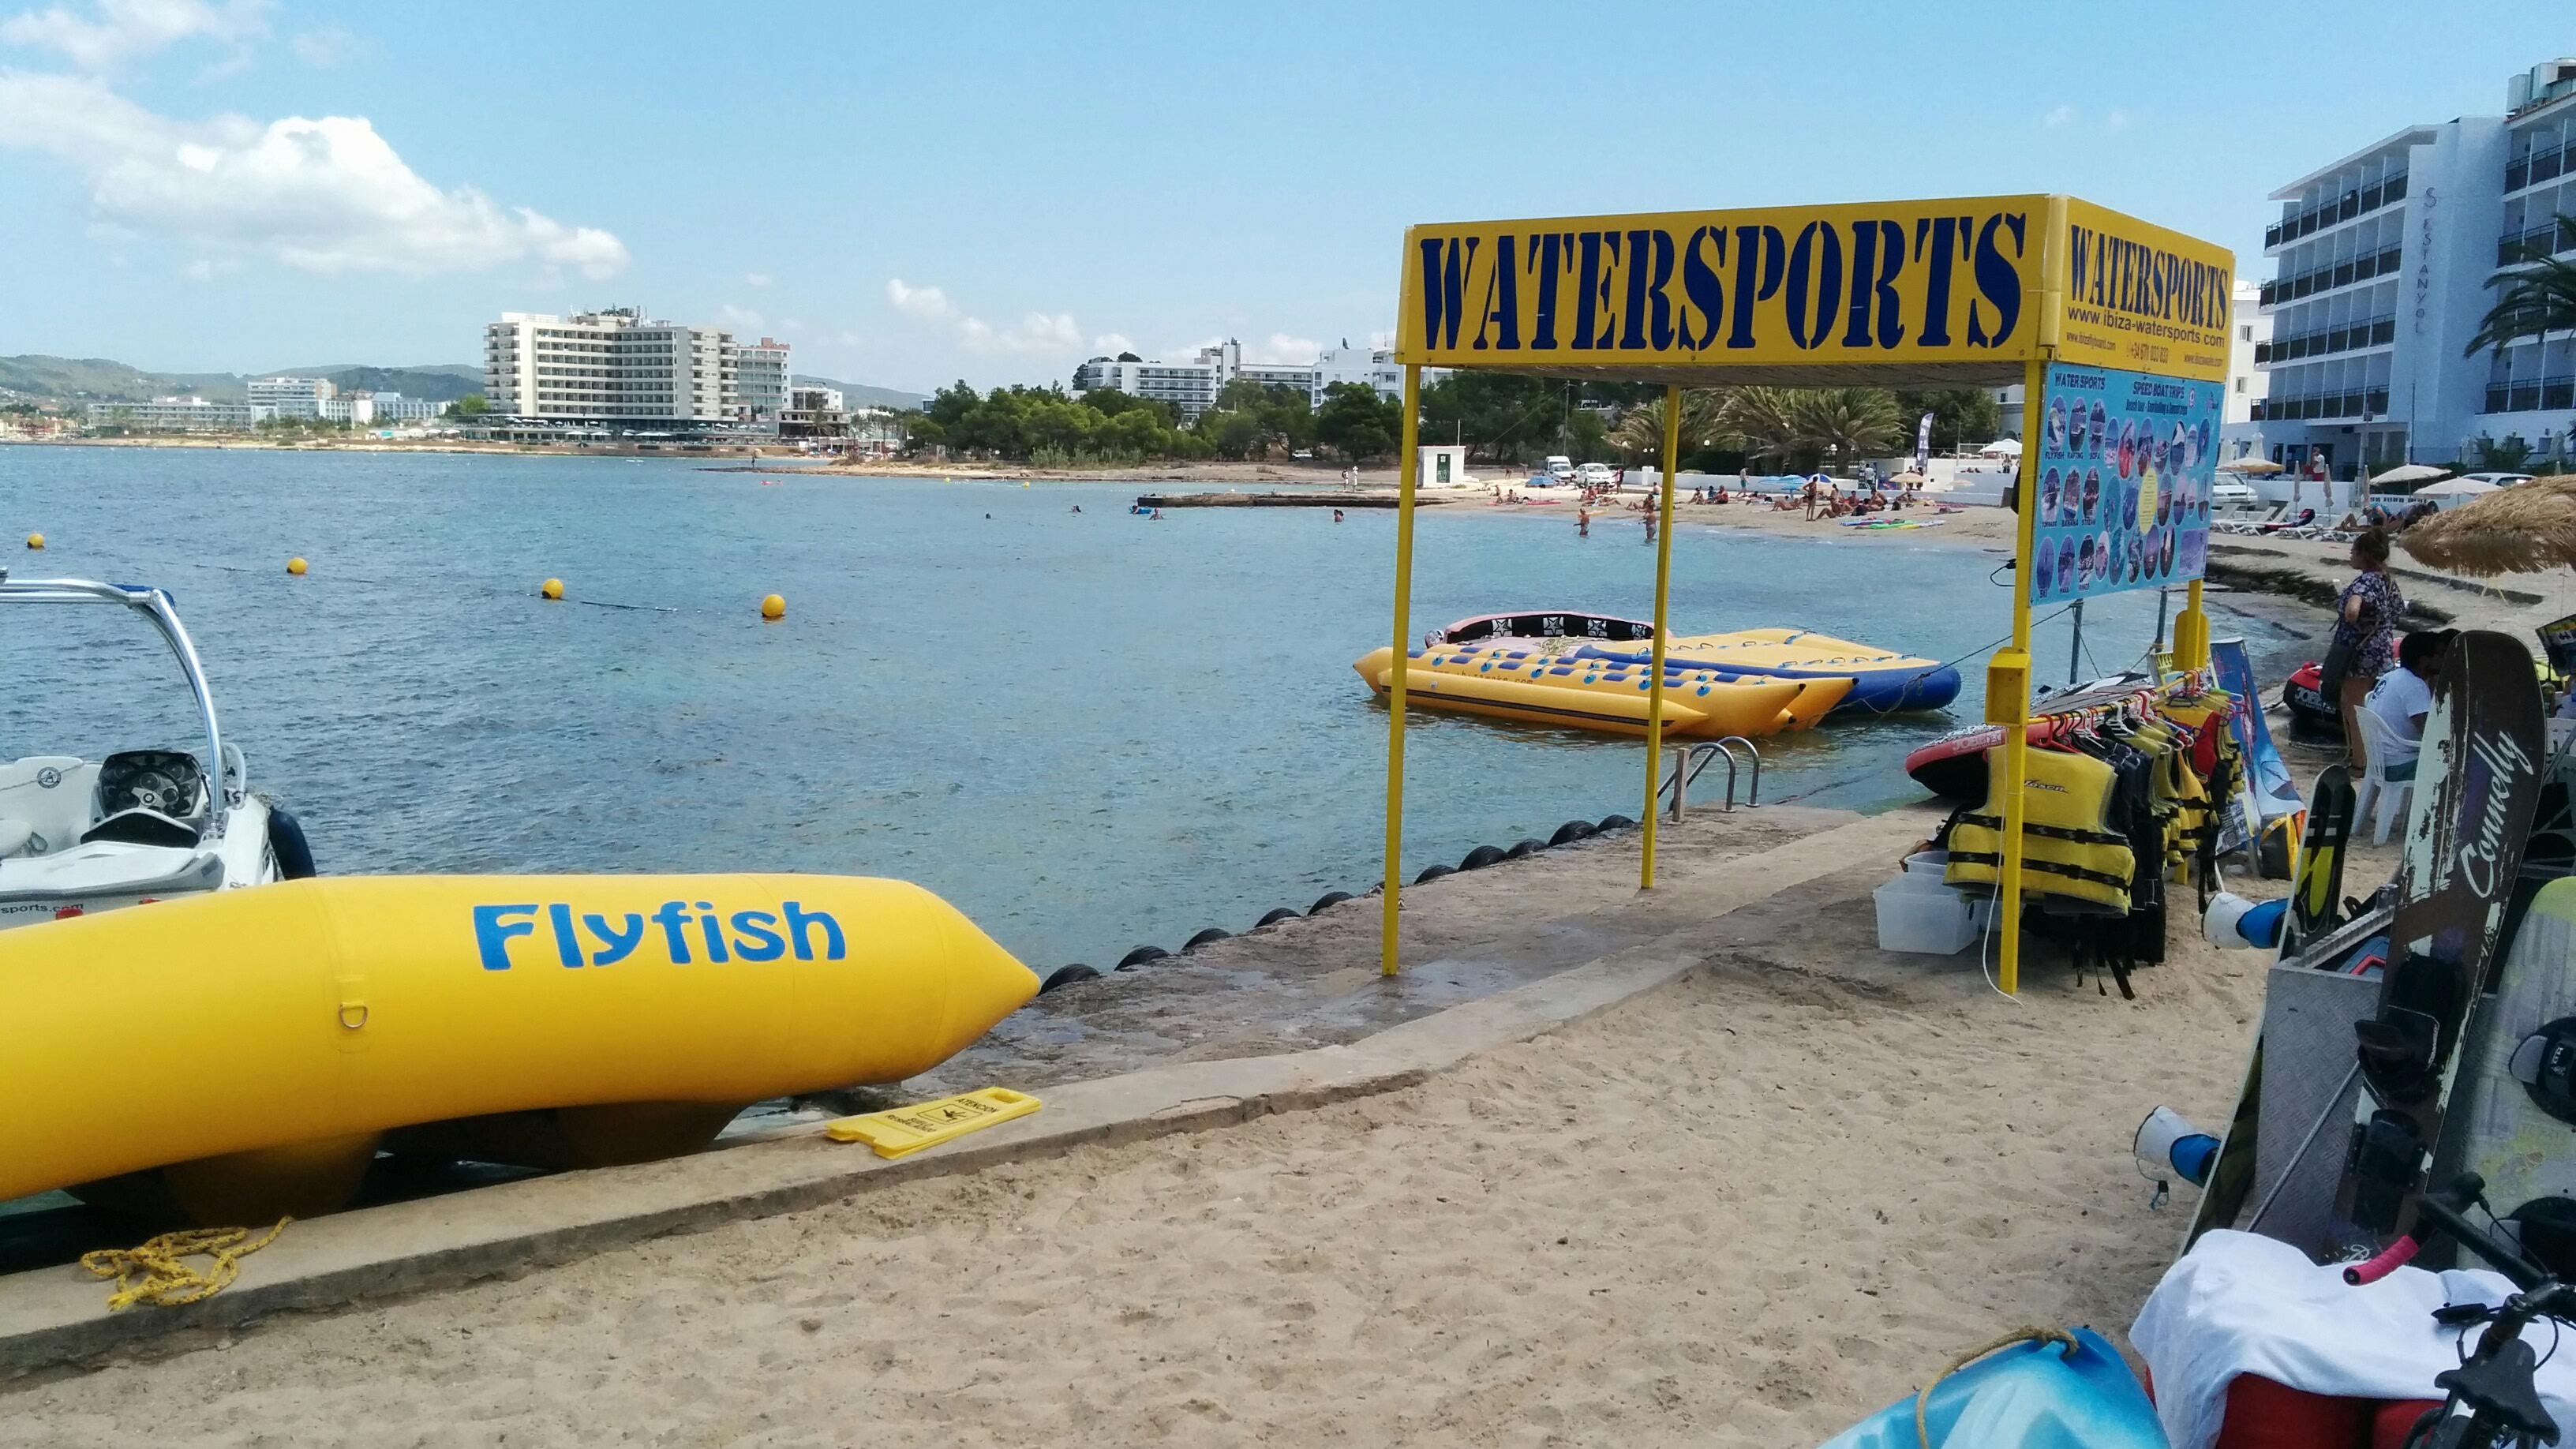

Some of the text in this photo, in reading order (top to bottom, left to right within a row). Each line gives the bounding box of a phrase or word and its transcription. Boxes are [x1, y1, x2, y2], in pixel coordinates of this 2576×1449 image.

[1420, 212, 2027, 351] WATERSPORTS
[2071, 224, 2229, 331] WATERSPORTS
[2460, 730, 2534, 898] Connelly
[473, 900, 846, 971] Flyfish
